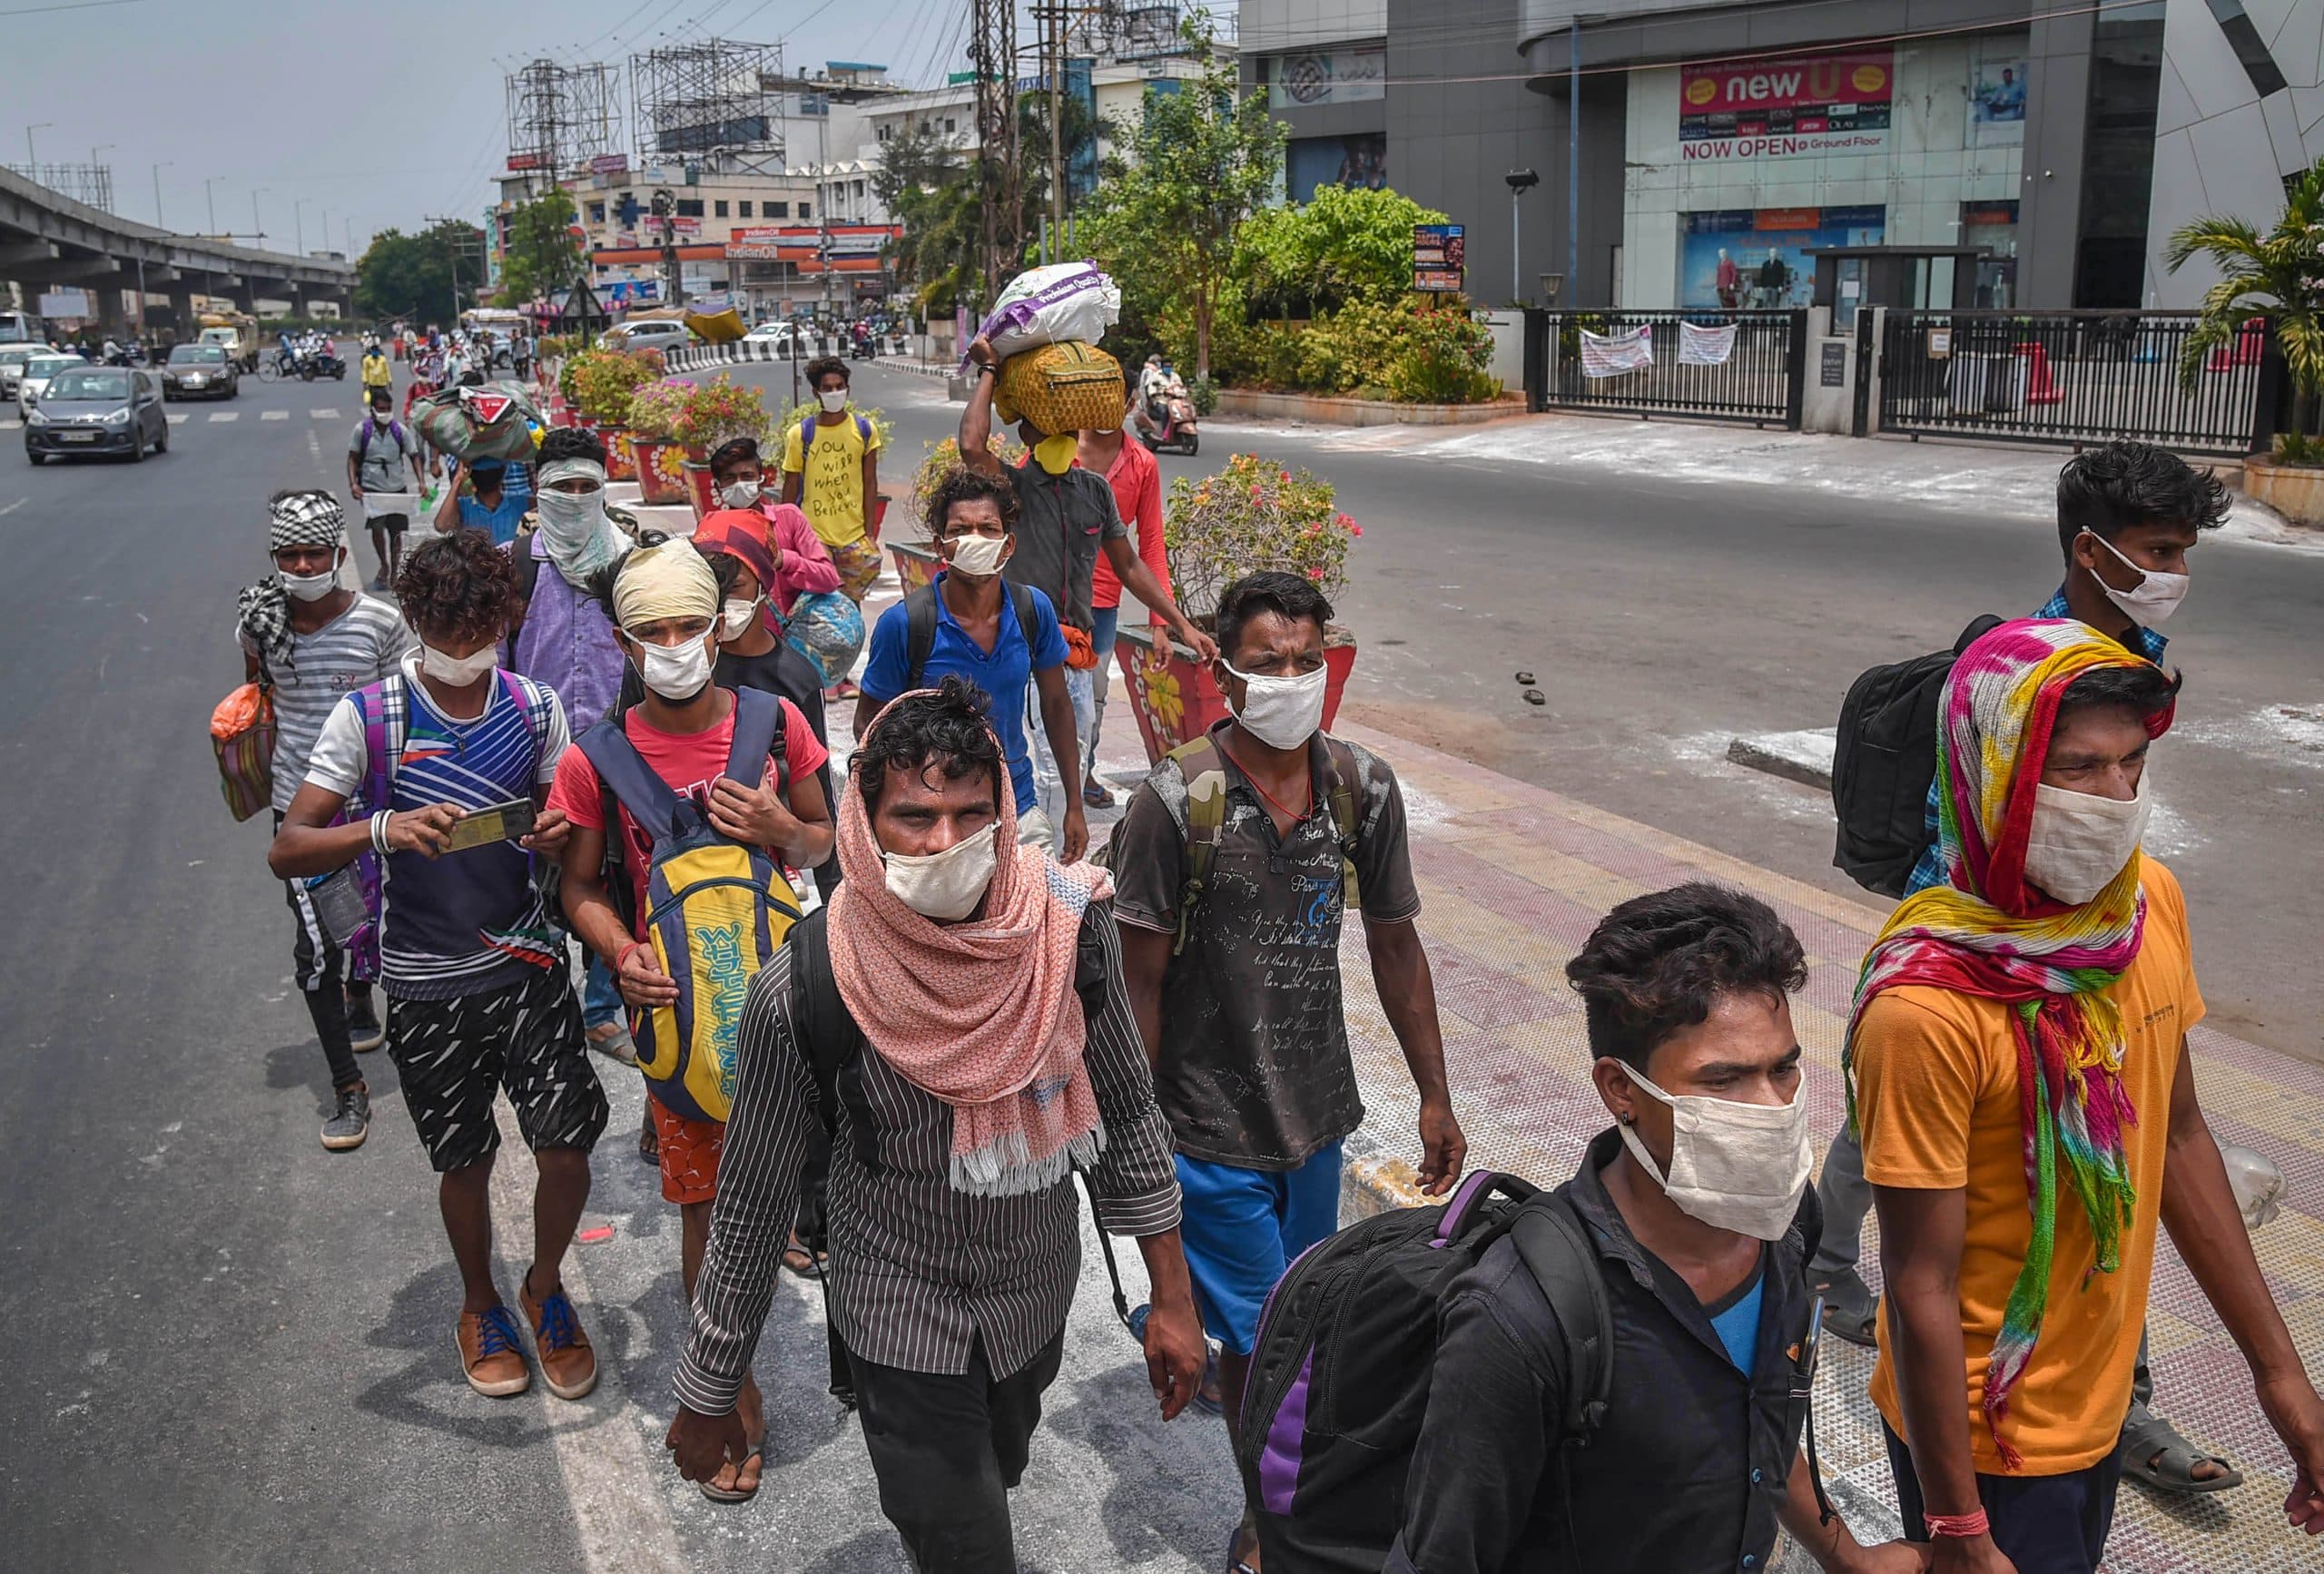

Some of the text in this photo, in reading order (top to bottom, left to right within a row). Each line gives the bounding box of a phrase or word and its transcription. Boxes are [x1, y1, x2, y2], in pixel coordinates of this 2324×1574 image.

[1727, 72, 1801, 102] new
[1682, 141, 1732, 161] NOW
[1738, 136, 1797, 157] OPEN
[1810, 137, 1851, 149] Ground
[1854, 136, 1882, 145] Floor
[744, 227, 780, 237] IndianOil
[725, 244, 778, 260] IndianOil
[1039, 282, 1077, 304] Premium
[814, 473, 849, 488] when
